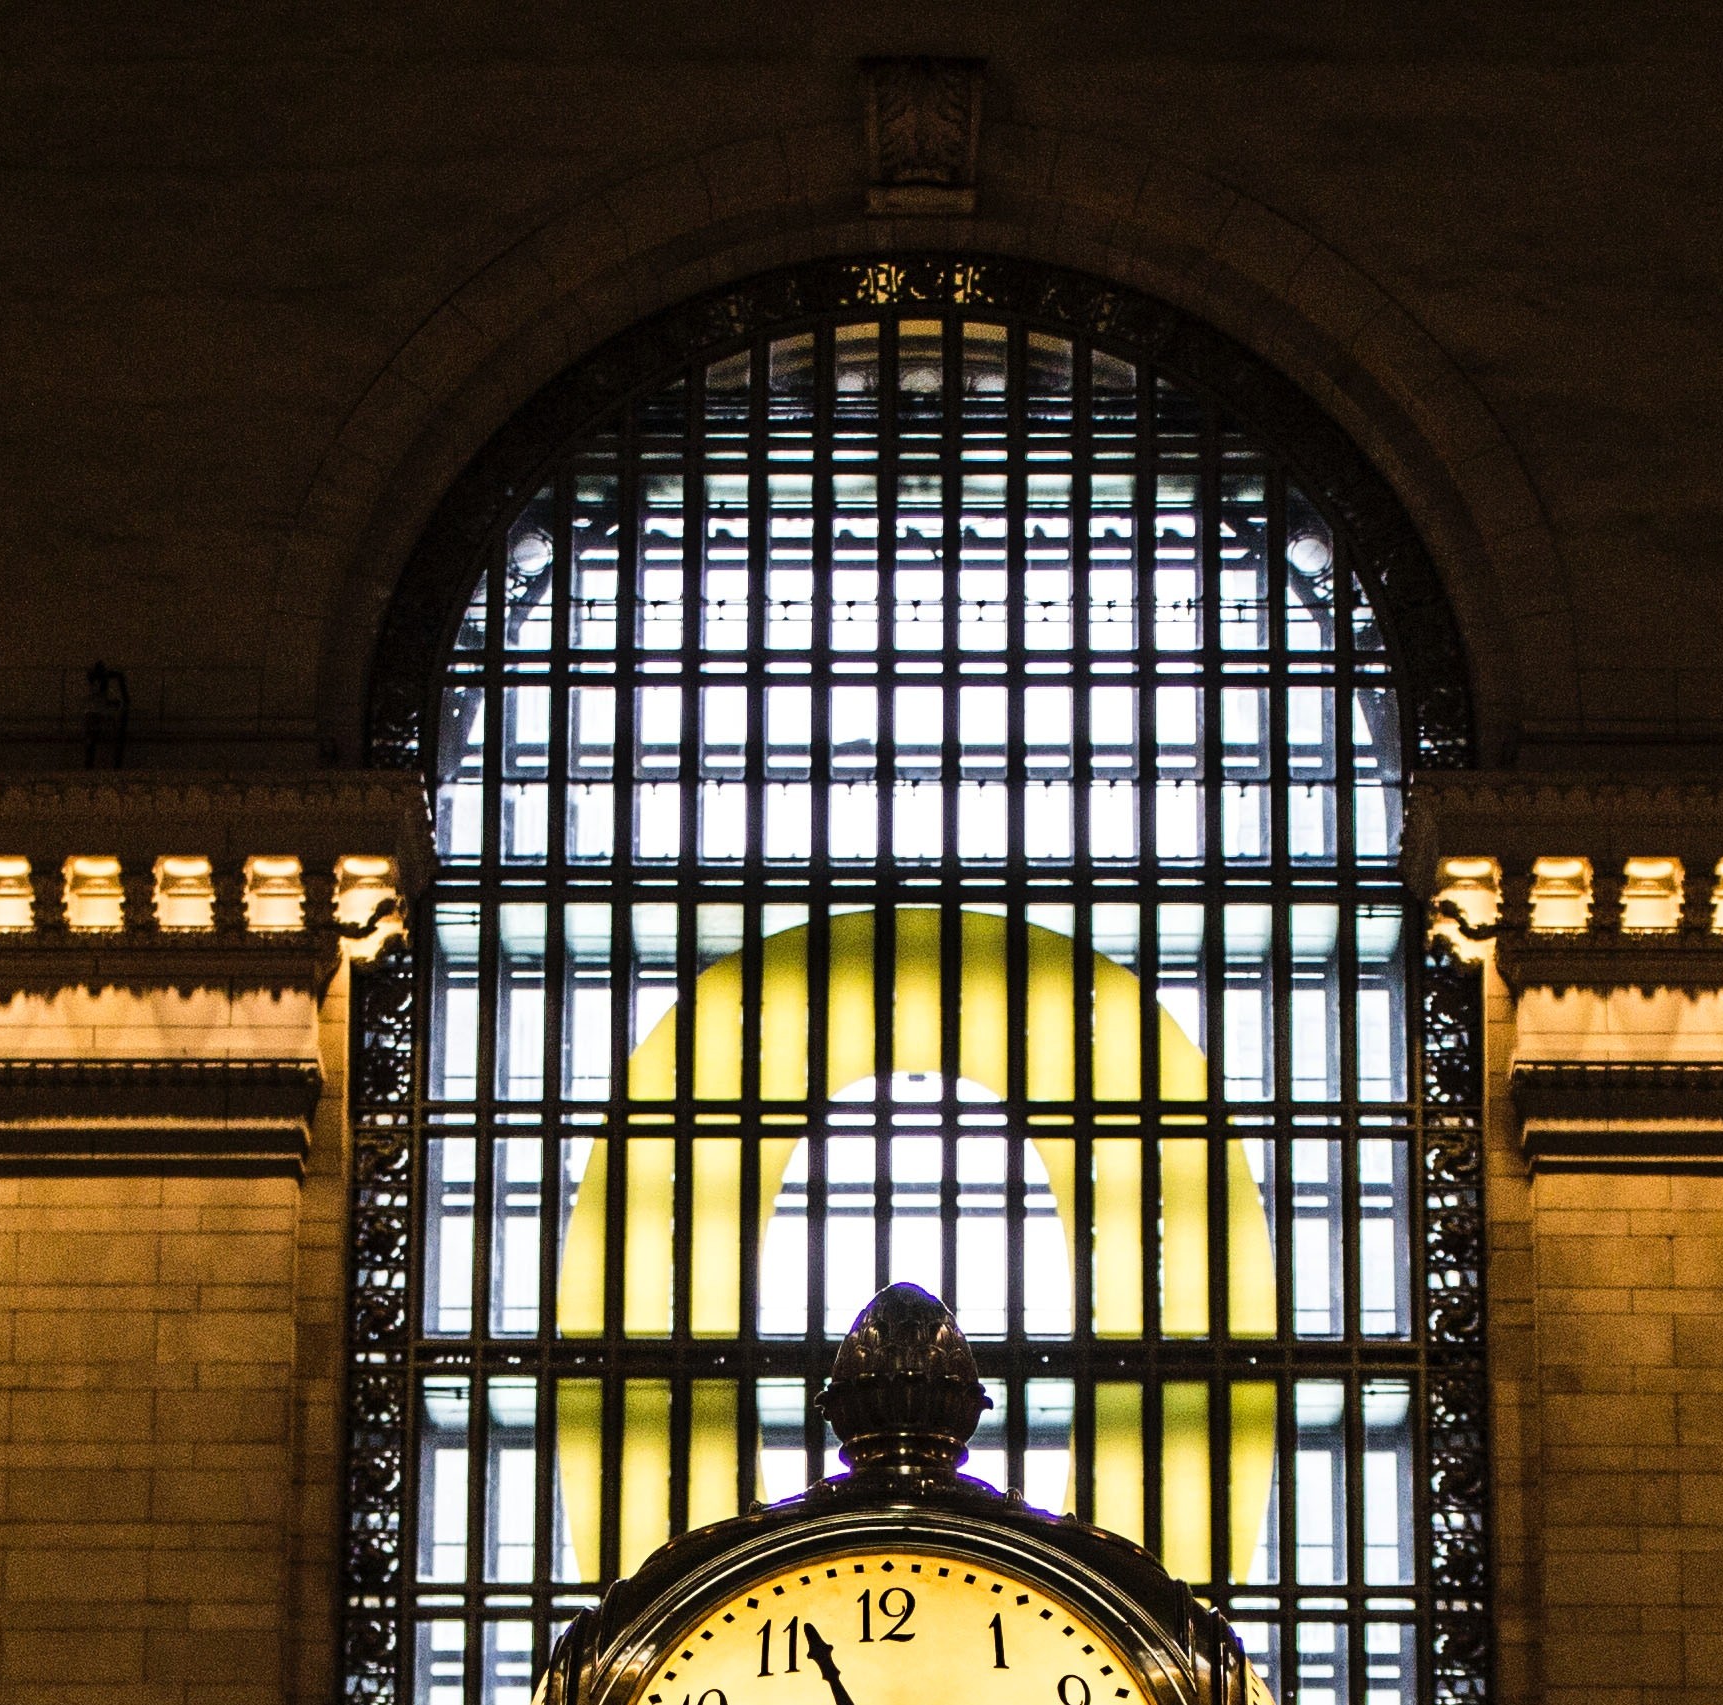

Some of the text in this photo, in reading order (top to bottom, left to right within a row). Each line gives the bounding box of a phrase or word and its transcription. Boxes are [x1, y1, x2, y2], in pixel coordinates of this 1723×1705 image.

[856, 1587, 916, 1643] 12
[988, 1612, 1010, 1670] 1
[756, 1615, 800, 1678] 11
